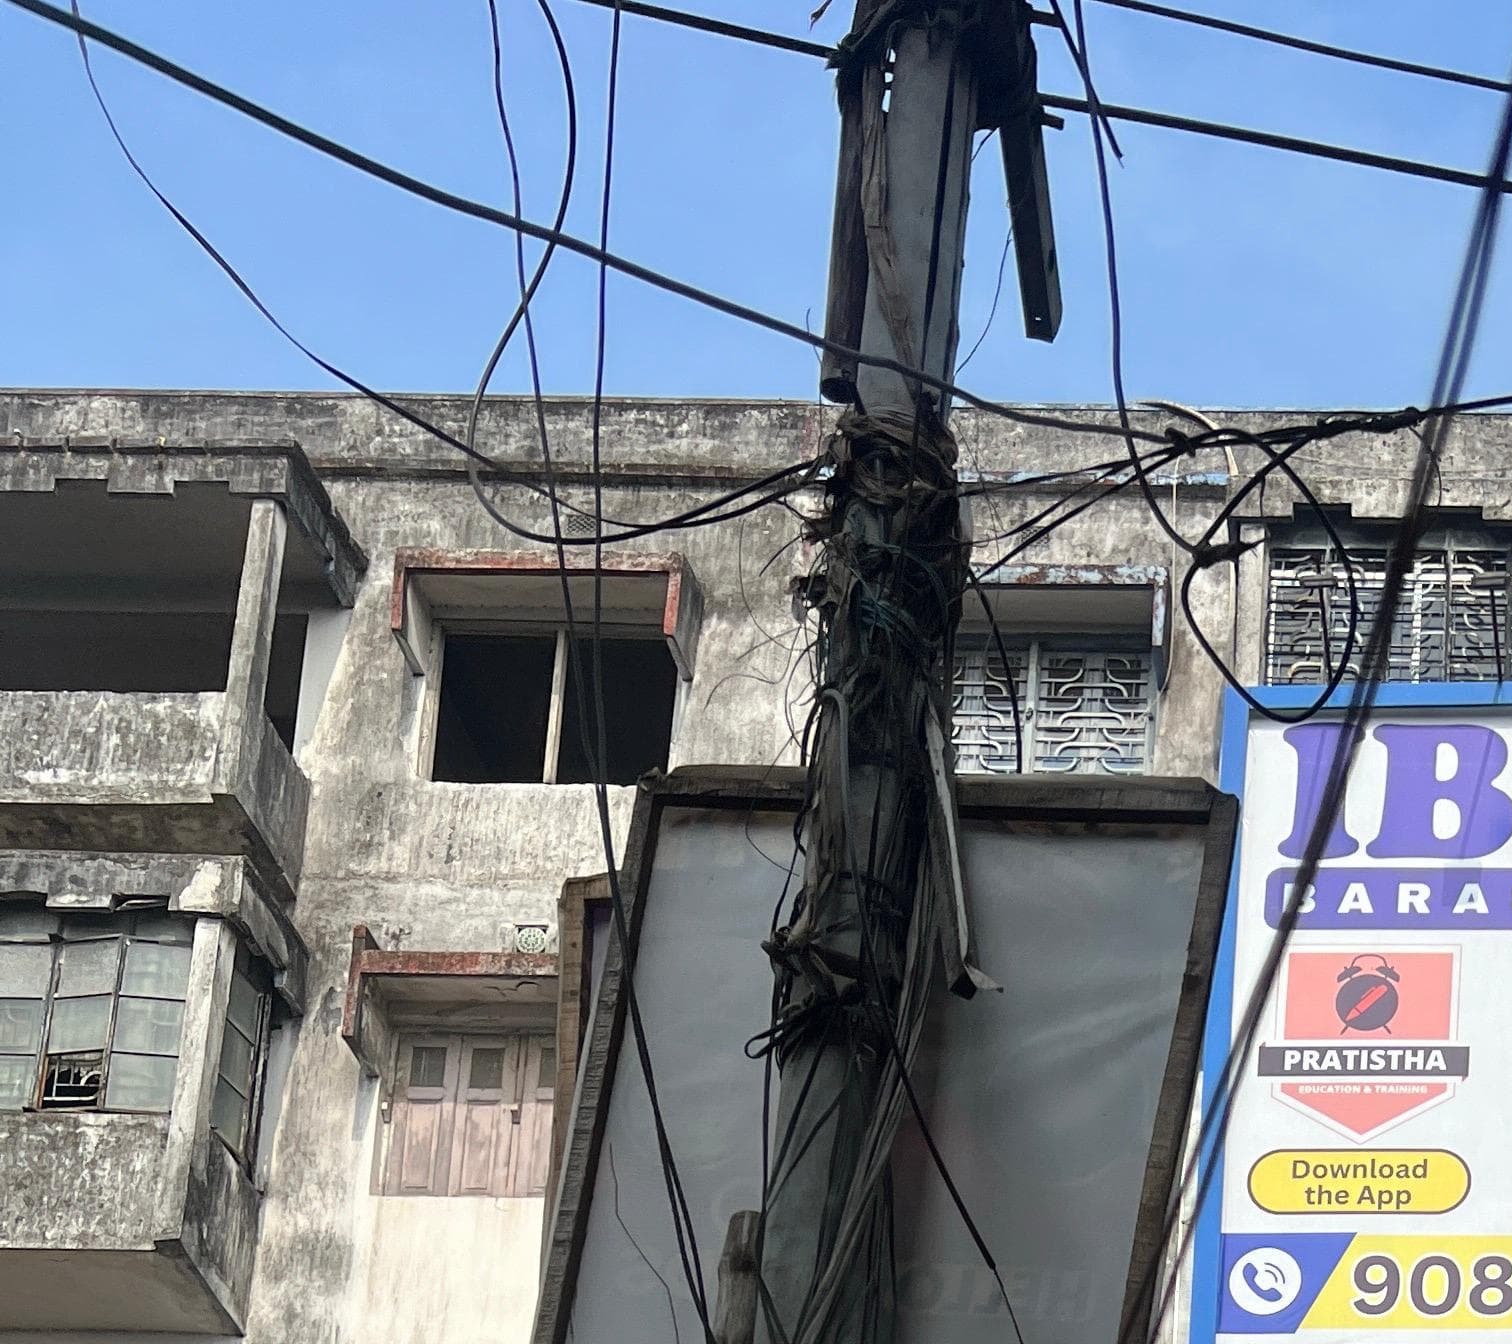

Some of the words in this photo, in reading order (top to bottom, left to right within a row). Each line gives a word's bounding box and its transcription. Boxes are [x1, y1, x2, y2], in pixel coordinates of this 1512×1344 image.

[1283, 1049, 1447, 1072] PRATISTHA
[1299, 1085, 1361, 1094] EDUCATION
[1363, 1084, 1373, 1094] &
[1375, 1085, 1428, 1094] TRAINING
[1292, 1159, 1428, 1179] Download
[1304, 1185, 1349, 1205] the
[1357, 1185, 1412, 1210] App
